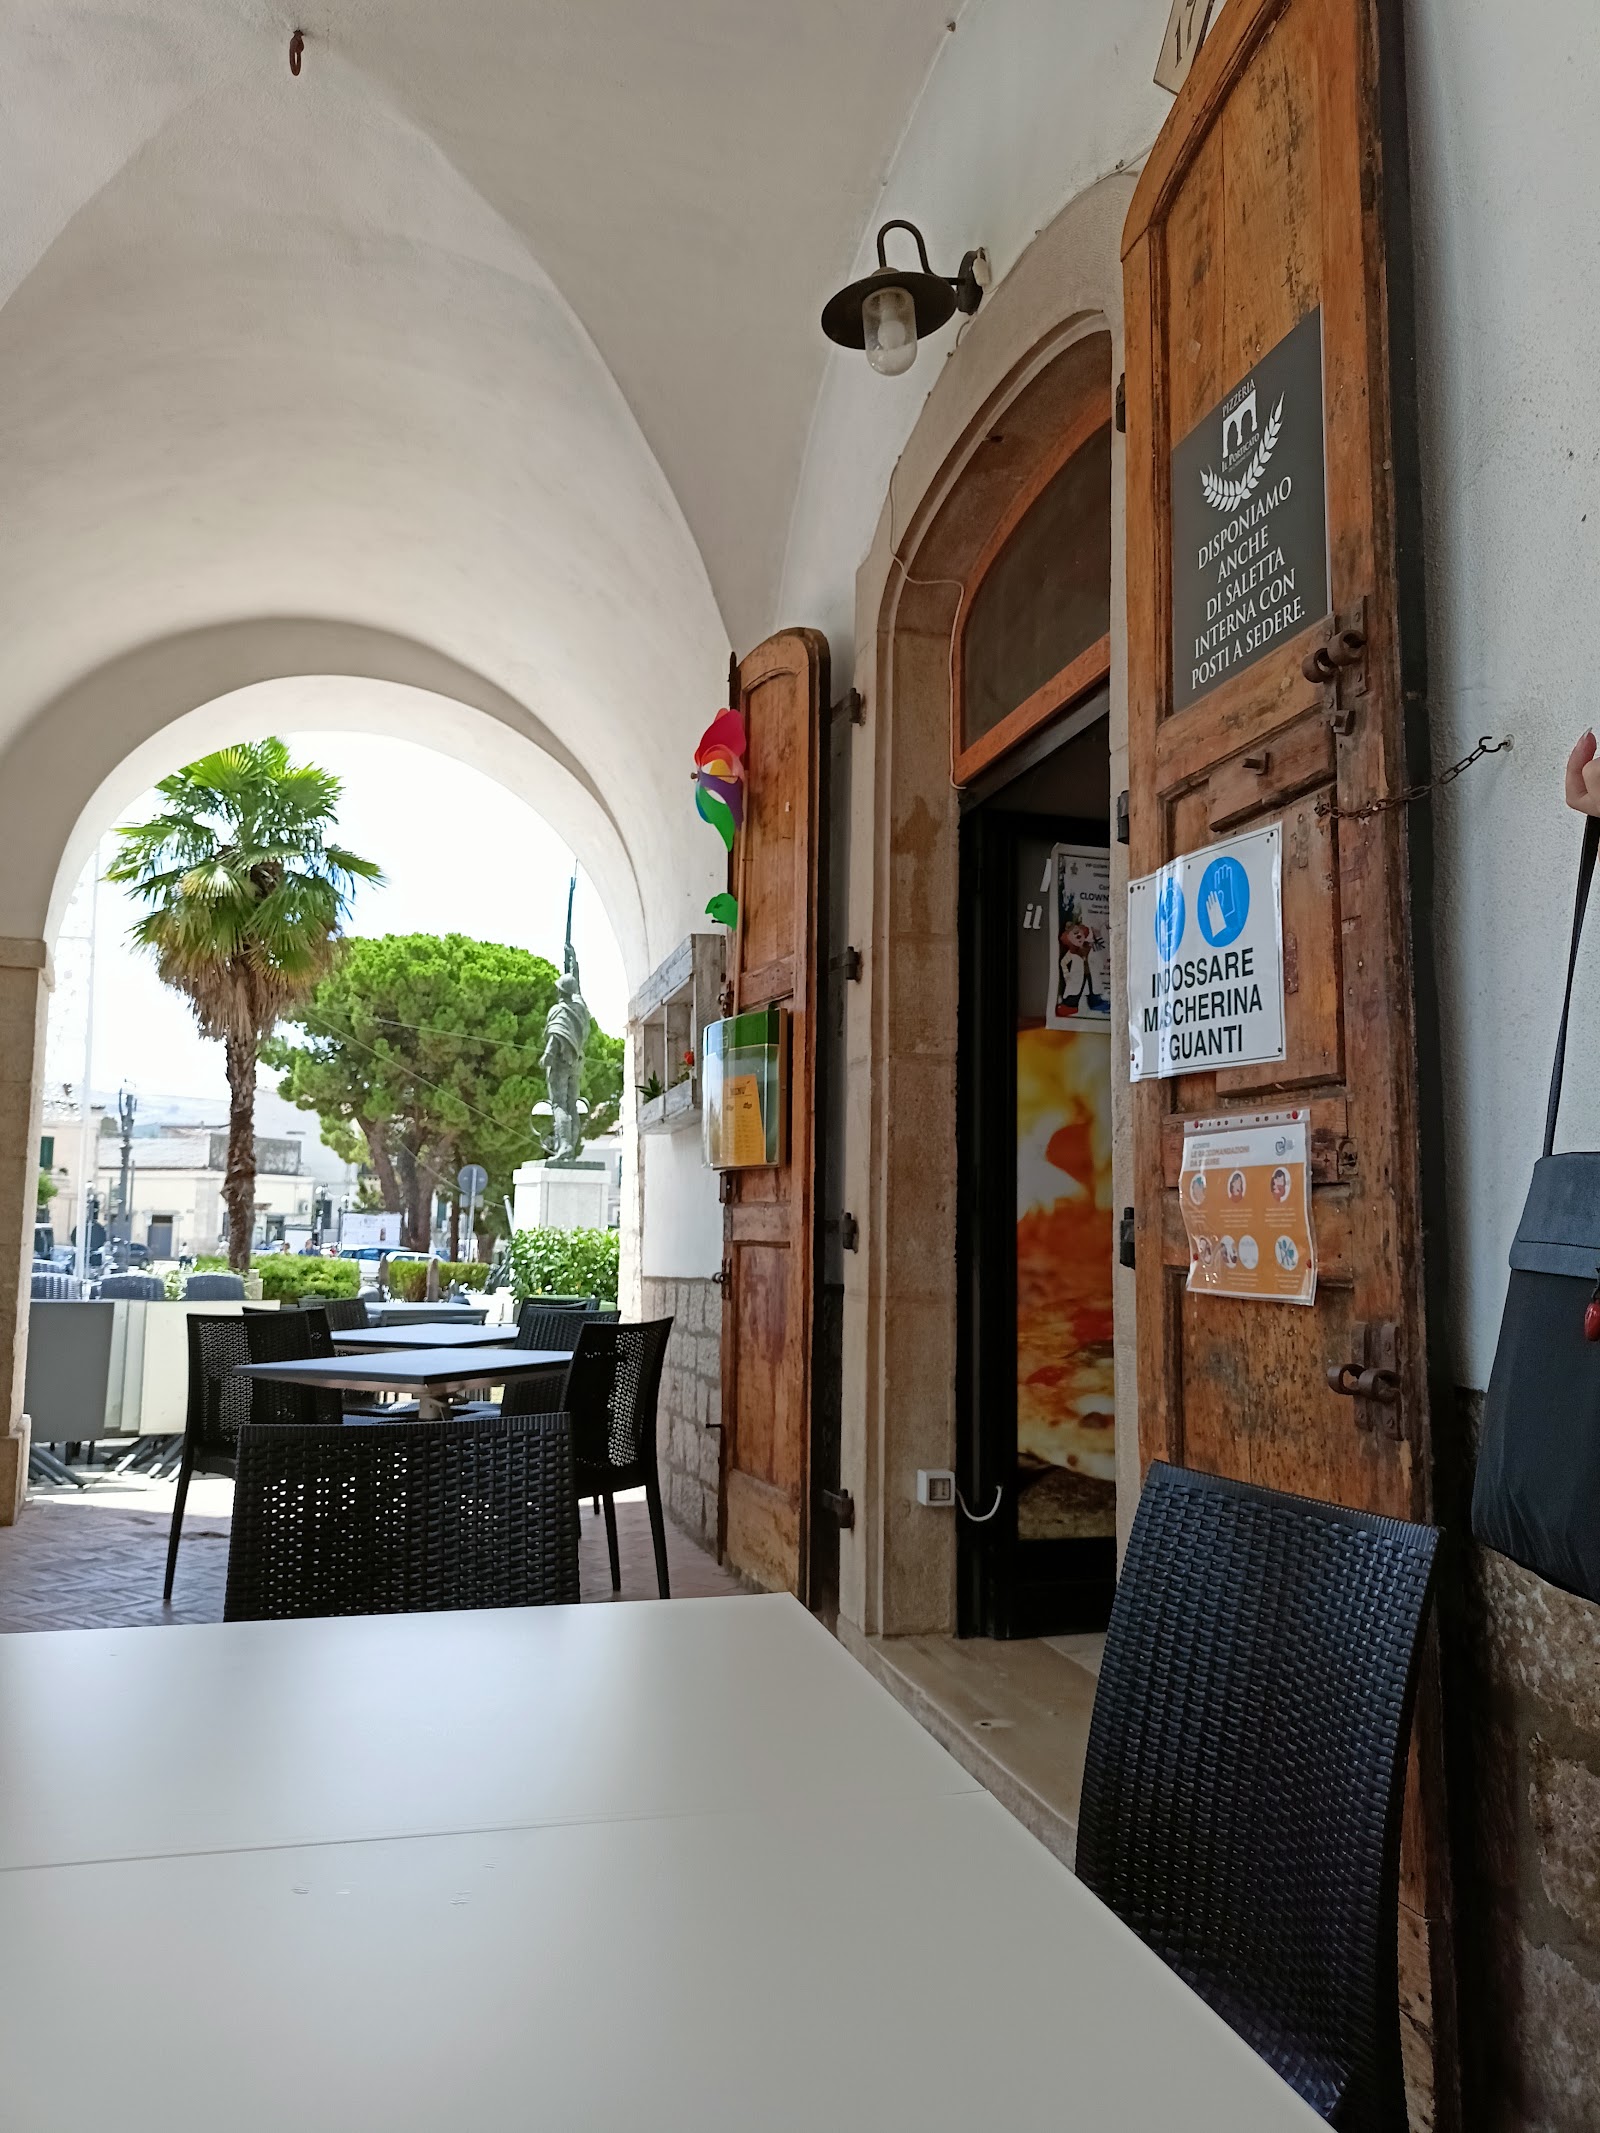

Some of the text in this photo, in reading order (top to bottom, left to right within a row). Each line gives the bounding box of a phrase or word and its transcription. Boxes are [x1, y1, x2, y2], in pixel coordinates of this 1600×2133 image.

[1222, 378, 1256, 418] PIZZERIA
[1228, 433, 1260, 466] PORTICATO
[1198, 476, 1293, 570] DISPONIAMO
[1206, 547, 1286, 621] DI SALETTA
[1217, 525, 1269, 584] ANCHE
[1191, 596, 1306, 691] POSTI A SEDERE.
[1194, 568, 1296, 660] INTERNA CON
[1152, 947, 1254, 998] INDOSSARE
[1169, 1024, 1243, 1061] GUANTI
